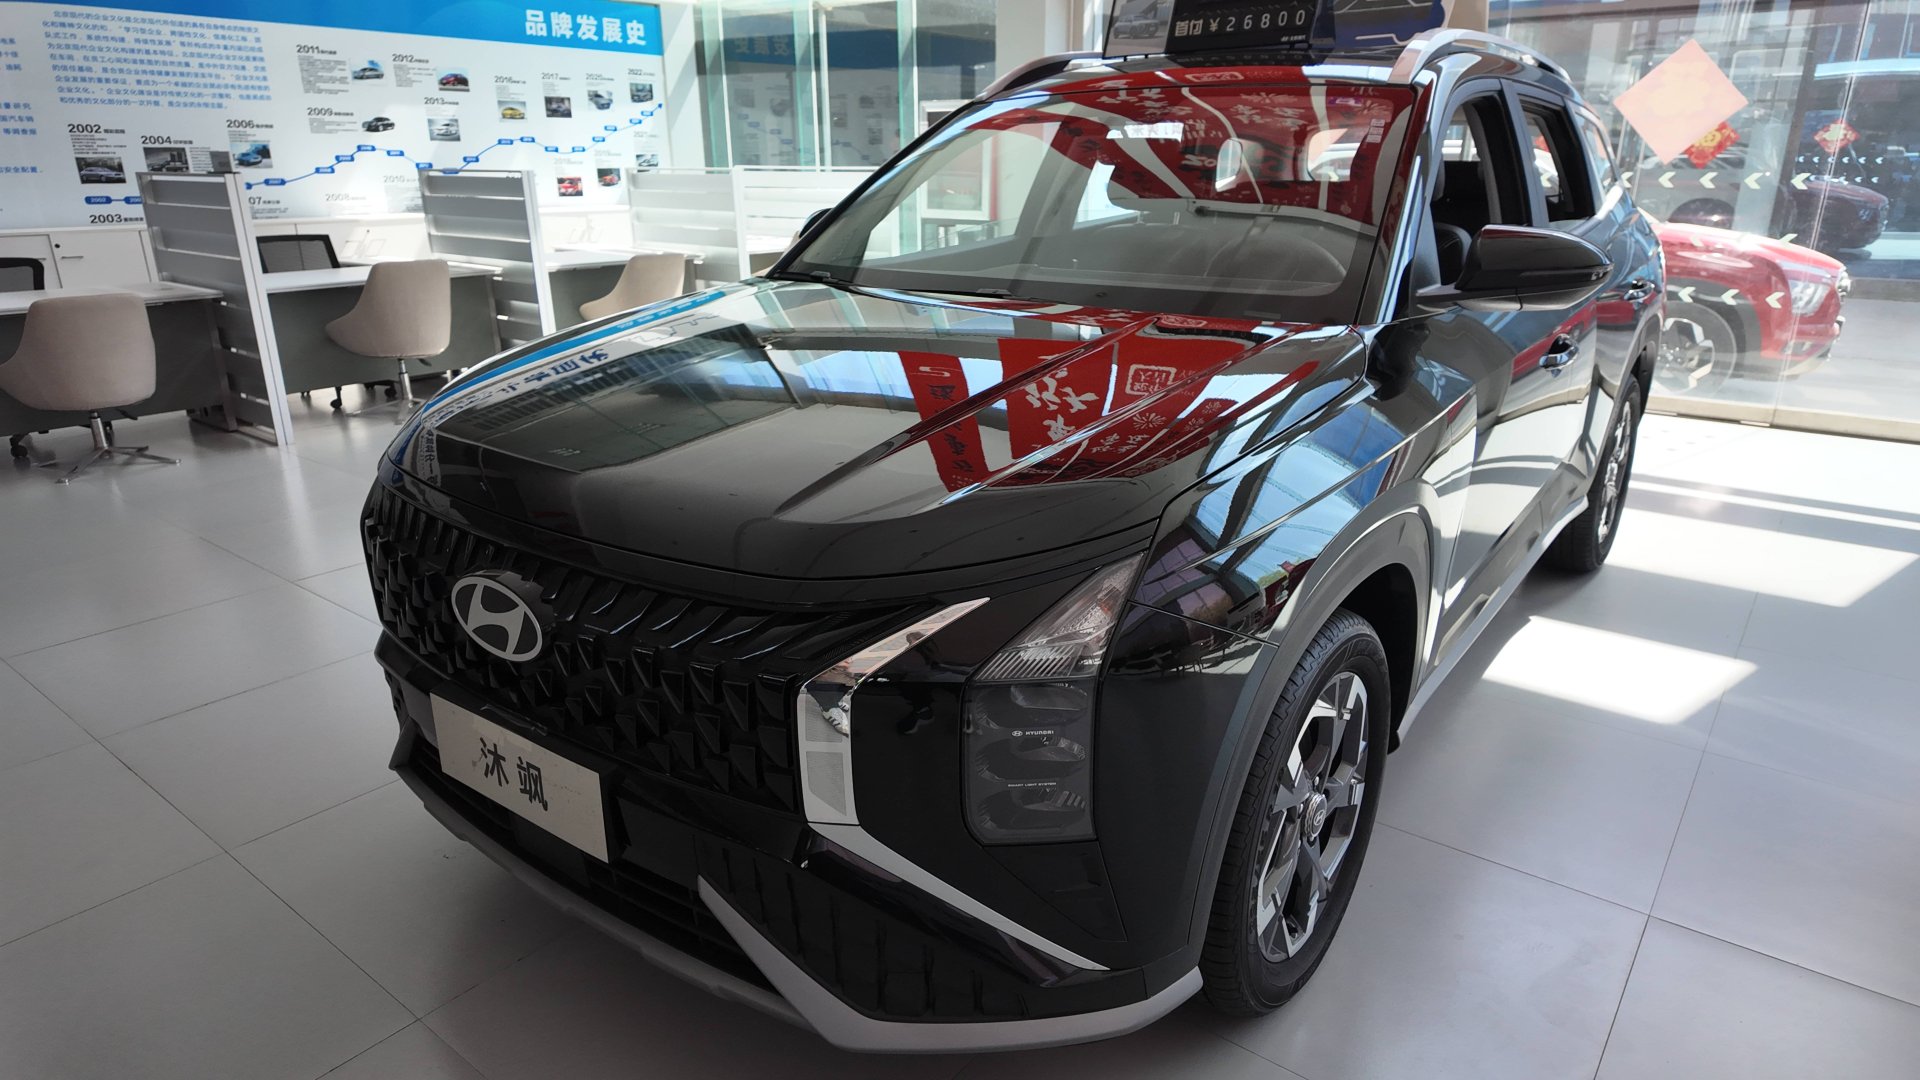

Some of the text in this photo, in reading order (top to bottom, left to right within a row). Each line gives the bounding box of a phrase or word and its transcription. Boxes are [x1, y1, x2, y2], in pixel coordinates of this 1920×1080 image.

[525, 9, 647, 46] 品牌发展史
[1175, 19, 1204, 37] 首付
[296, 44, 320, 54] 2011
[392, 53, 415, 62] 2012
[541, 72, 558, 80] 2017
[307, 107, 333, 116] 2009
[68, 123, 102, 134] 2002
[226, 119, 255, 129] 2006
[141, 135, 172, 145] 2004
[89, 214, 123, 224] 2003
[479, 737, 548, 812] 沐飒
